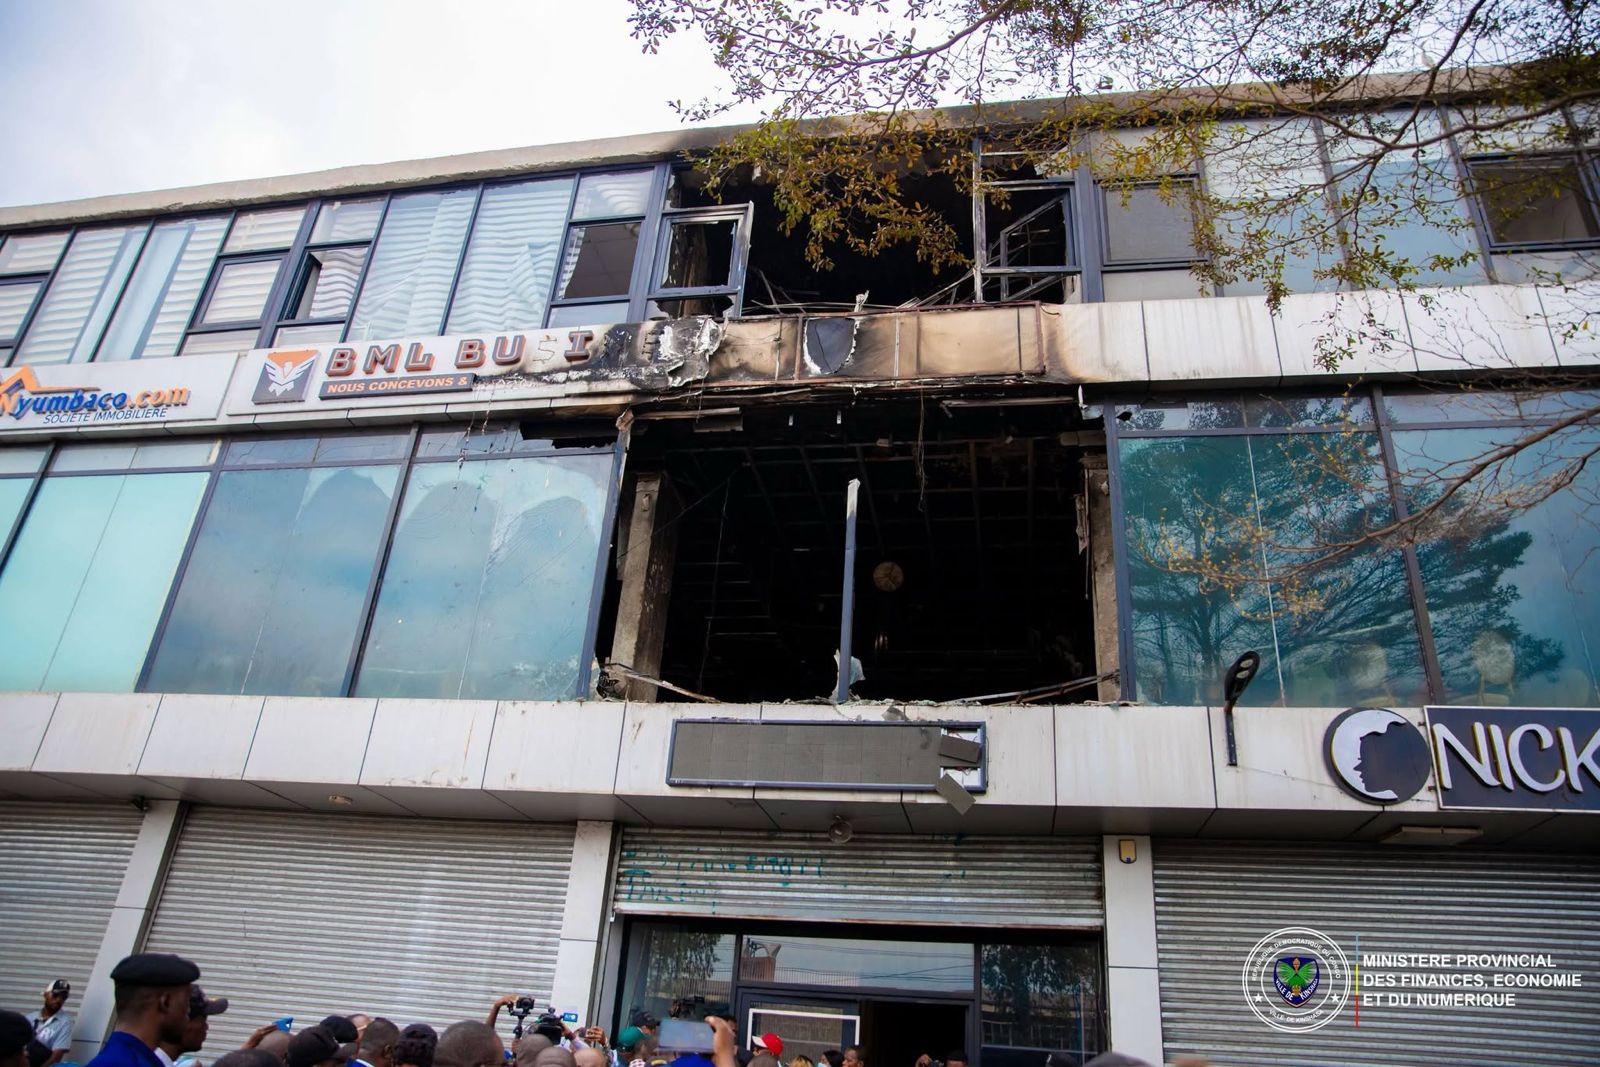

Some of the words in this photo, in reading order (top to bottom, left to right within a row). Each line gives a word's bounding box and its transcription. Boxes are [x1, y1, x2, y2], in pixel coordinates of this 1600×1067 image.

[326, 342, 436, 377] BML
[327, 382, 365, 394] NOUS
[368, 377, 453, 391] CONCEVONS
[458, 376, 468, 386] &
[42, 412, 91, 424] SOCIETE
[93, 408, 168, 421] IMMOBILIERE
